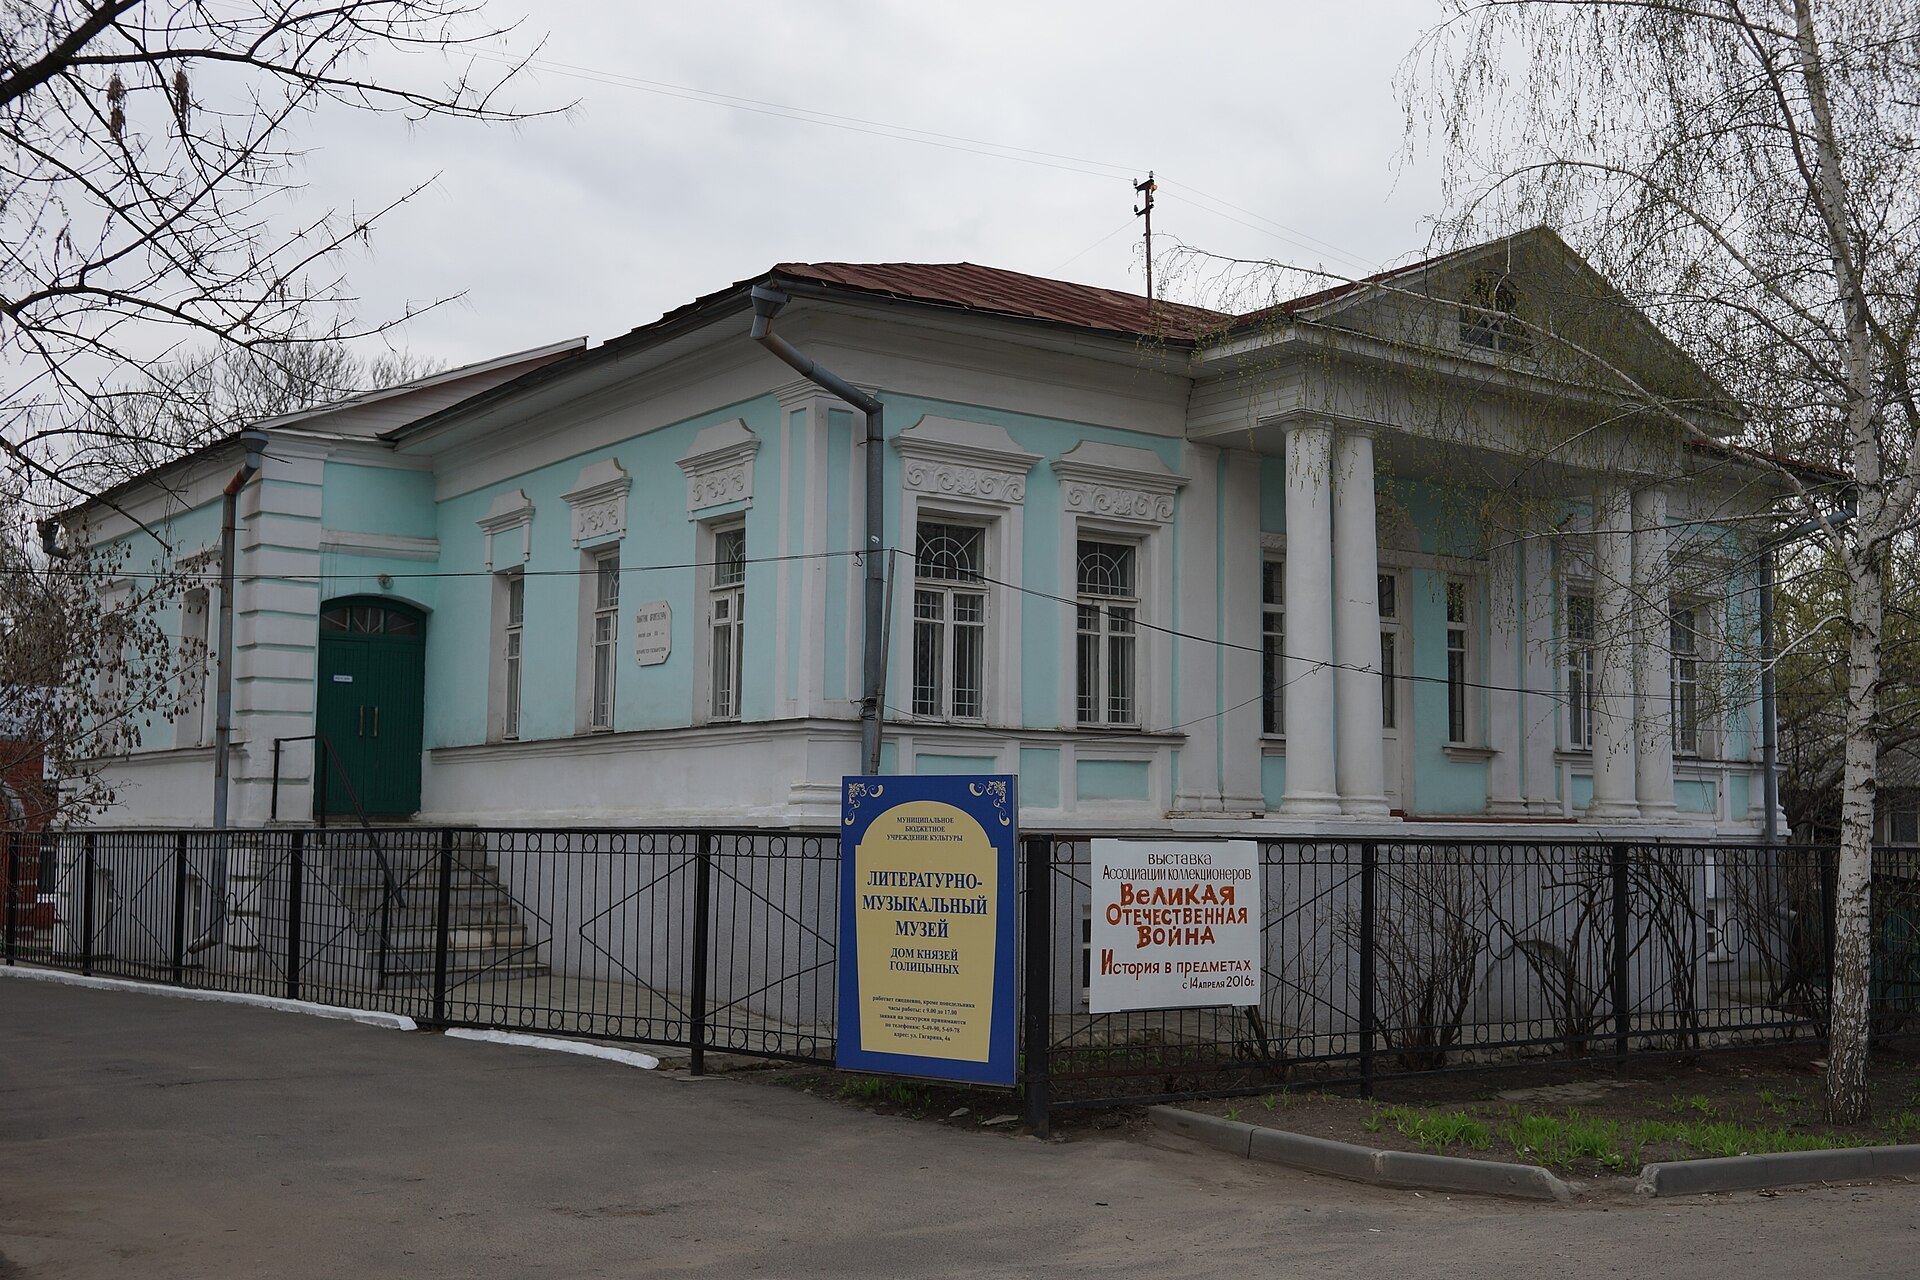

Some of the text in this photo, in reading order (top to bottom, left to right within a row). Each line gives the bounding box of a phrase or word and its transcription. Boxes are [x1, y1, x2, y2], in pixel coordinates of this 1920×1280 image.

[905, 825, 946, 833] БЮДЖЕТНОЕ
[886, 834, 928, 842] УЧРЕЖДЕНИЕ
[867, 870, 983, 890] ЛИТЕРАТУРНО-
[1102, 865, 1252, 884] Ассоциации коллекционеров
[862, 895, 988, 914] МУЗЫКАЛЬНЫЙ
[895, 918, 949, 938] МУЗЕЙ
[890, 948, 958, 961] ДОМ КНЯЗЕЙ
[890, 960, 960, 975] ГОЛИЦЫНЫХ
